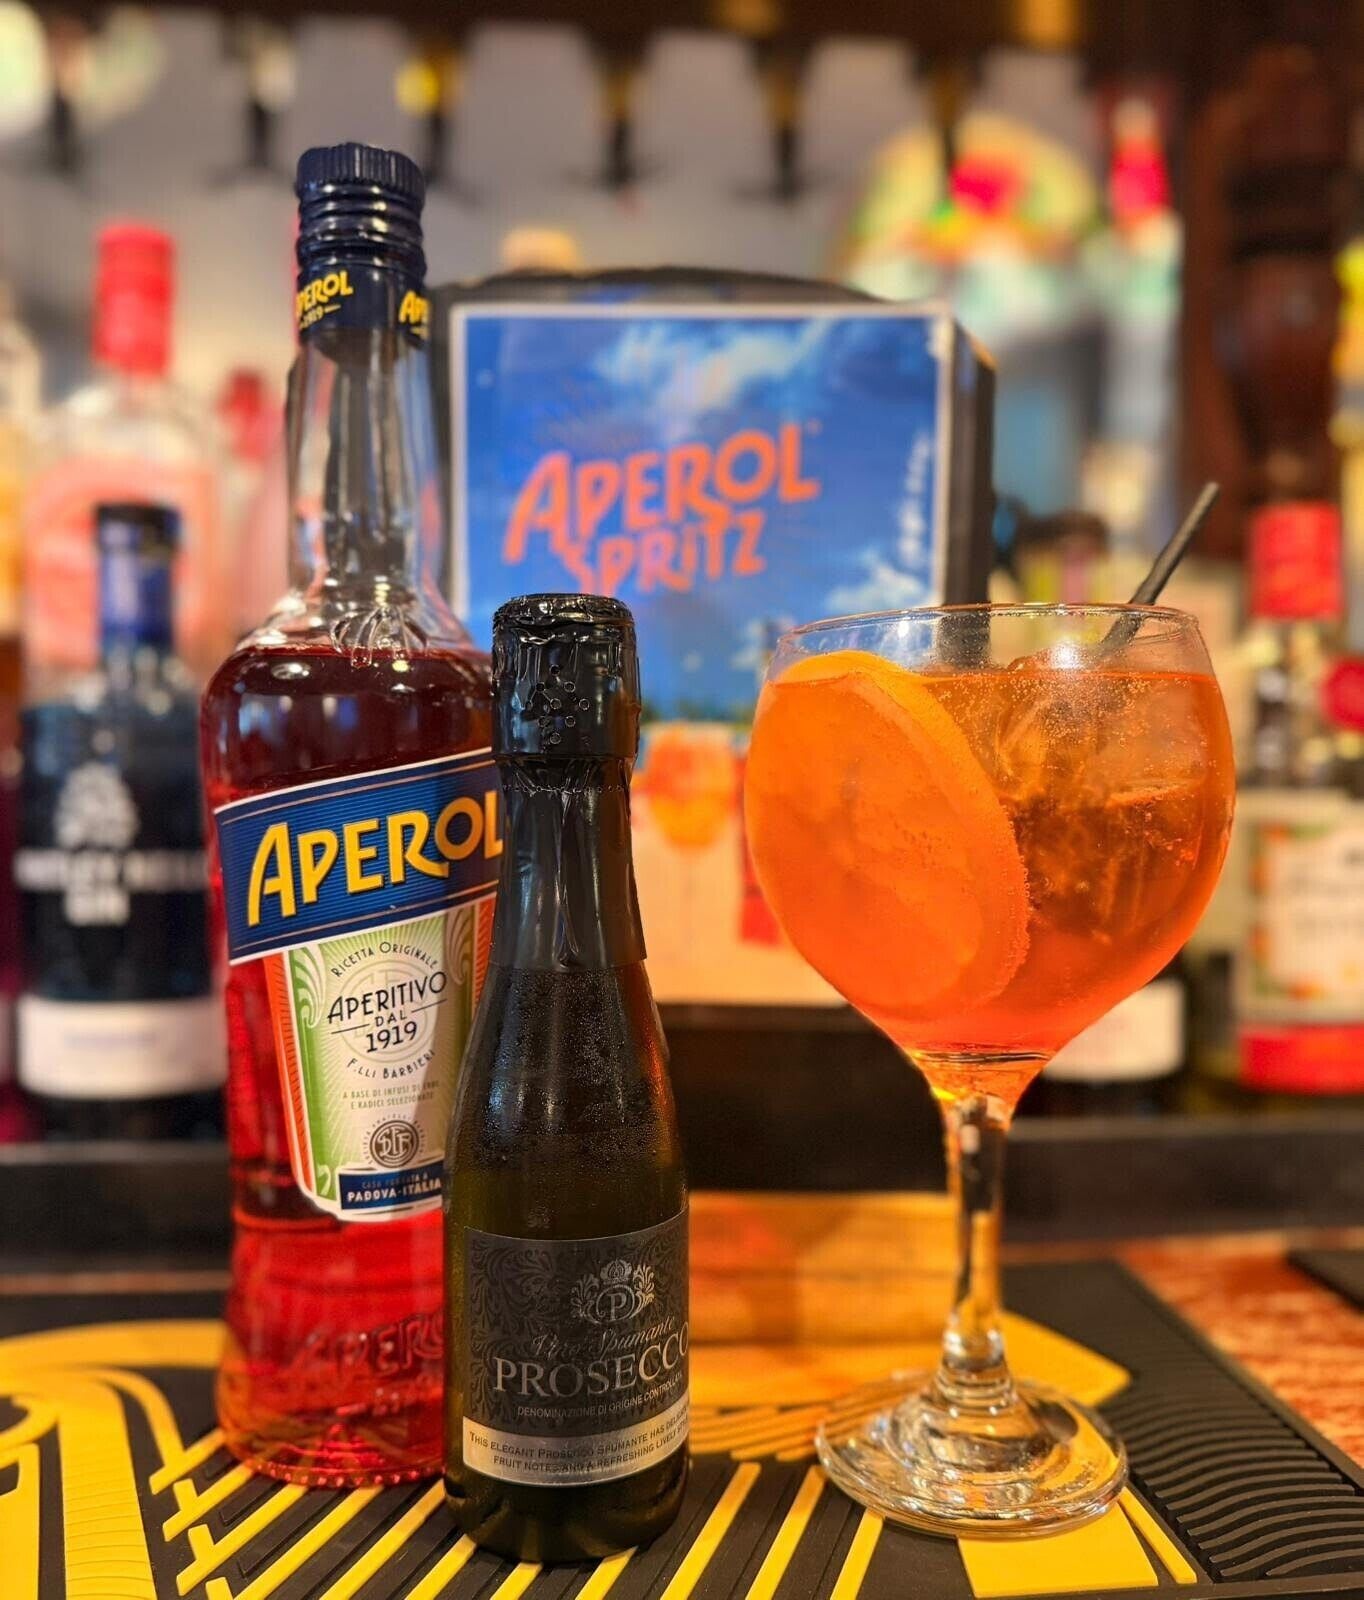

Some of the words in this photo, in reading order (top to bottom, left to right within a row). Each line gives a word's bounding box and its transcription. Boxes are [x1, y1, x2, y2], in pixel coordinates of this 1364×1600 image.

[503, 423, 821, 565] APEROL
[247, 790, 504, 928] APEROL
[330, 947, 375, 978] RICETTA
[379, 941, 439, 969] ORIGINALE
[328, 971, 447, 1025] APERITIVO
[375, 1009, 407, 1027] DAL
[366, 1020, 417, 1053] 1919
[383, 1049, 436, 1080] BARBIERI
[493, 1321, 689, 1399] PROSECCO
[470, 1431, 489, 1448] THIS
[490, 1441, 536, 1457] ELEGANT
[597, 1432, 648, 1455] SPUMANTE
[493, 1455, 521, 1470] FRUIT
[597, 1444, 655, 1469] REFRESHING
